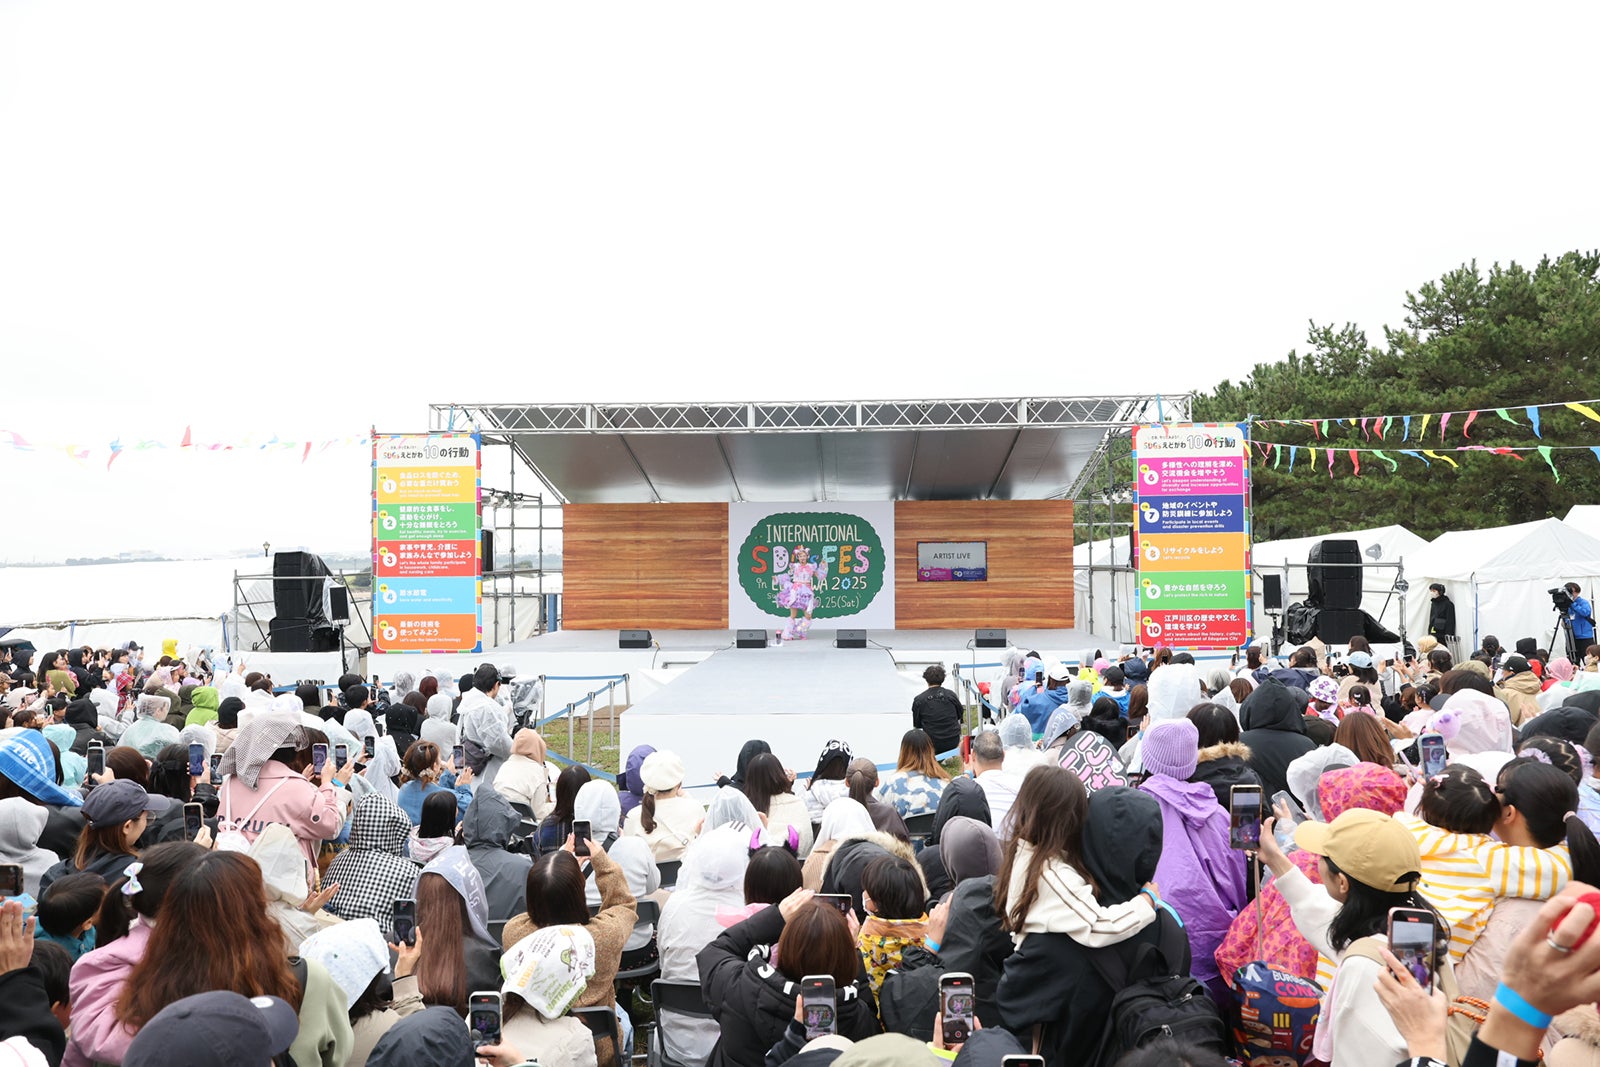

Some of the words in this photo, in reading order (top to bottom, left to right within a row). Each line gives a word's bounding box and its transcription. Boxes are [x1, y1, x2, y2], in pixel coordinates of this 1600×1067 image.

[766, 524, 862, 542] INTERNATIONAL
[822, 545, 870, 574] FES
[831, 576, 867, 590] 2025
